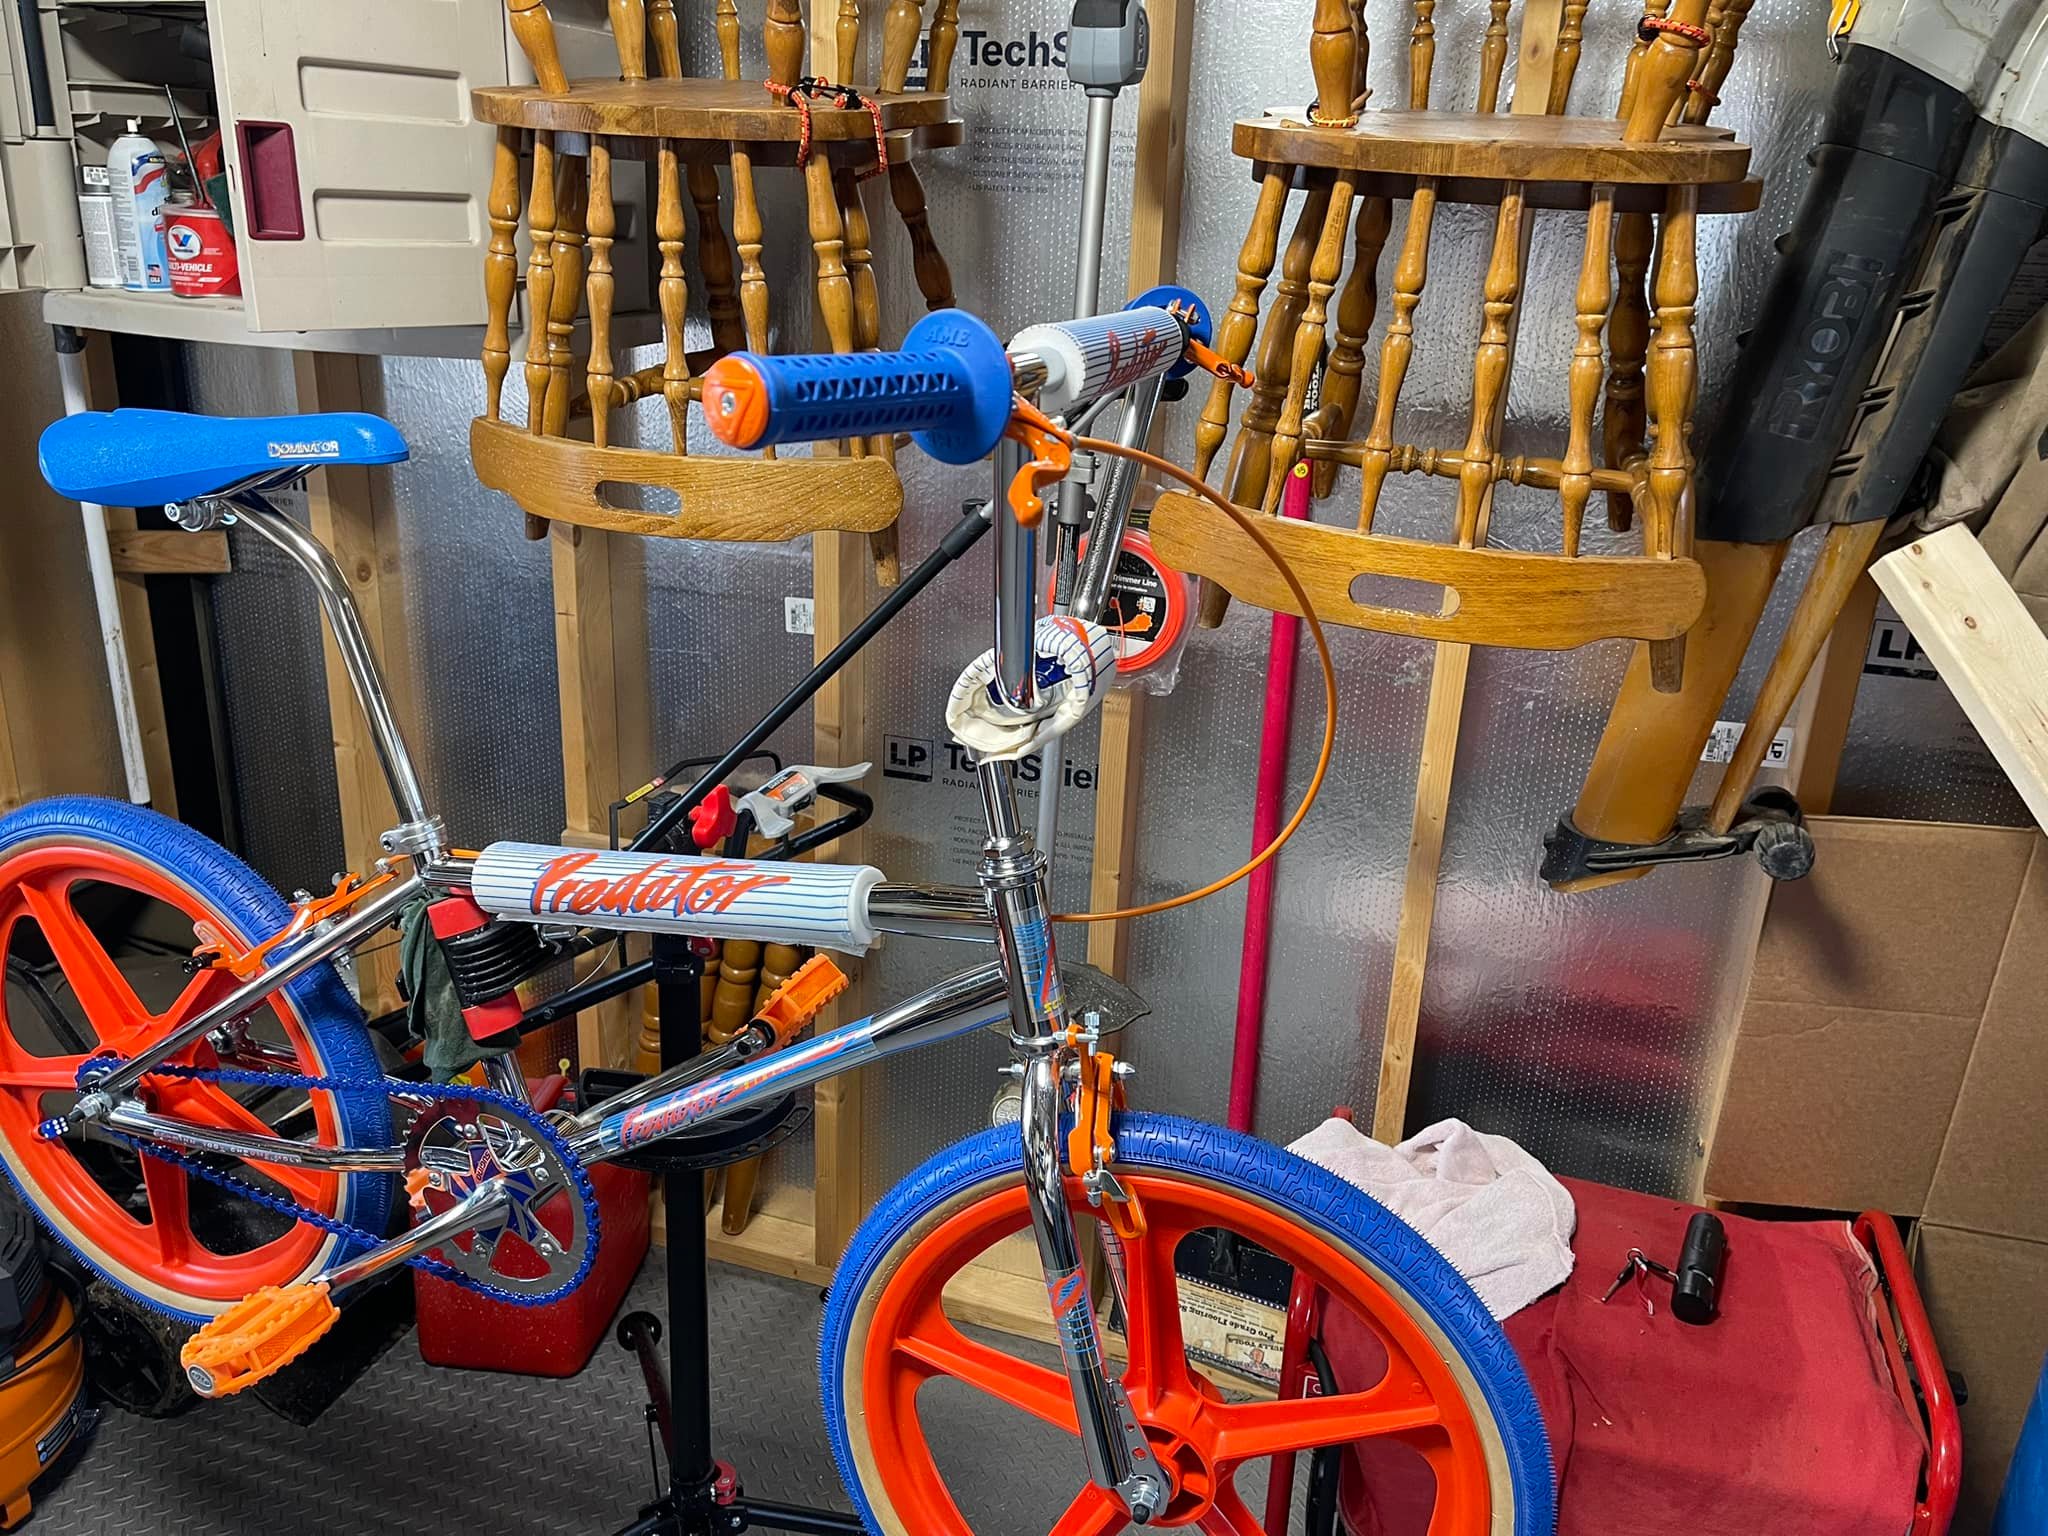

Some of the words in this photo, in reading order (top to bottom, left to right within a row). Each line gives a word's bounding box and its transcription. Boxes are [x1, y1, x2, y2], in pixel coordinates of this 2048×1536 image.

[960, 77, 1017, 89] RADIANT
[1021, 79, 1077, 90] BARRIER
[924, 324, 972, 348] AME
[268, 440, 340, 457] DOMINATOR
[890, 742, 928, 768] LP
[1771, 743, 1784, 759] LP
[530, 852, 792, 918] Predator
[476, 1151, 492, 1181] SUGINO
[1189, 1306, 1228, 1327] Flooring
[1229, 1320, 1257, 1336] Grade
[1258, 1330, 1275, 1342] Pro
